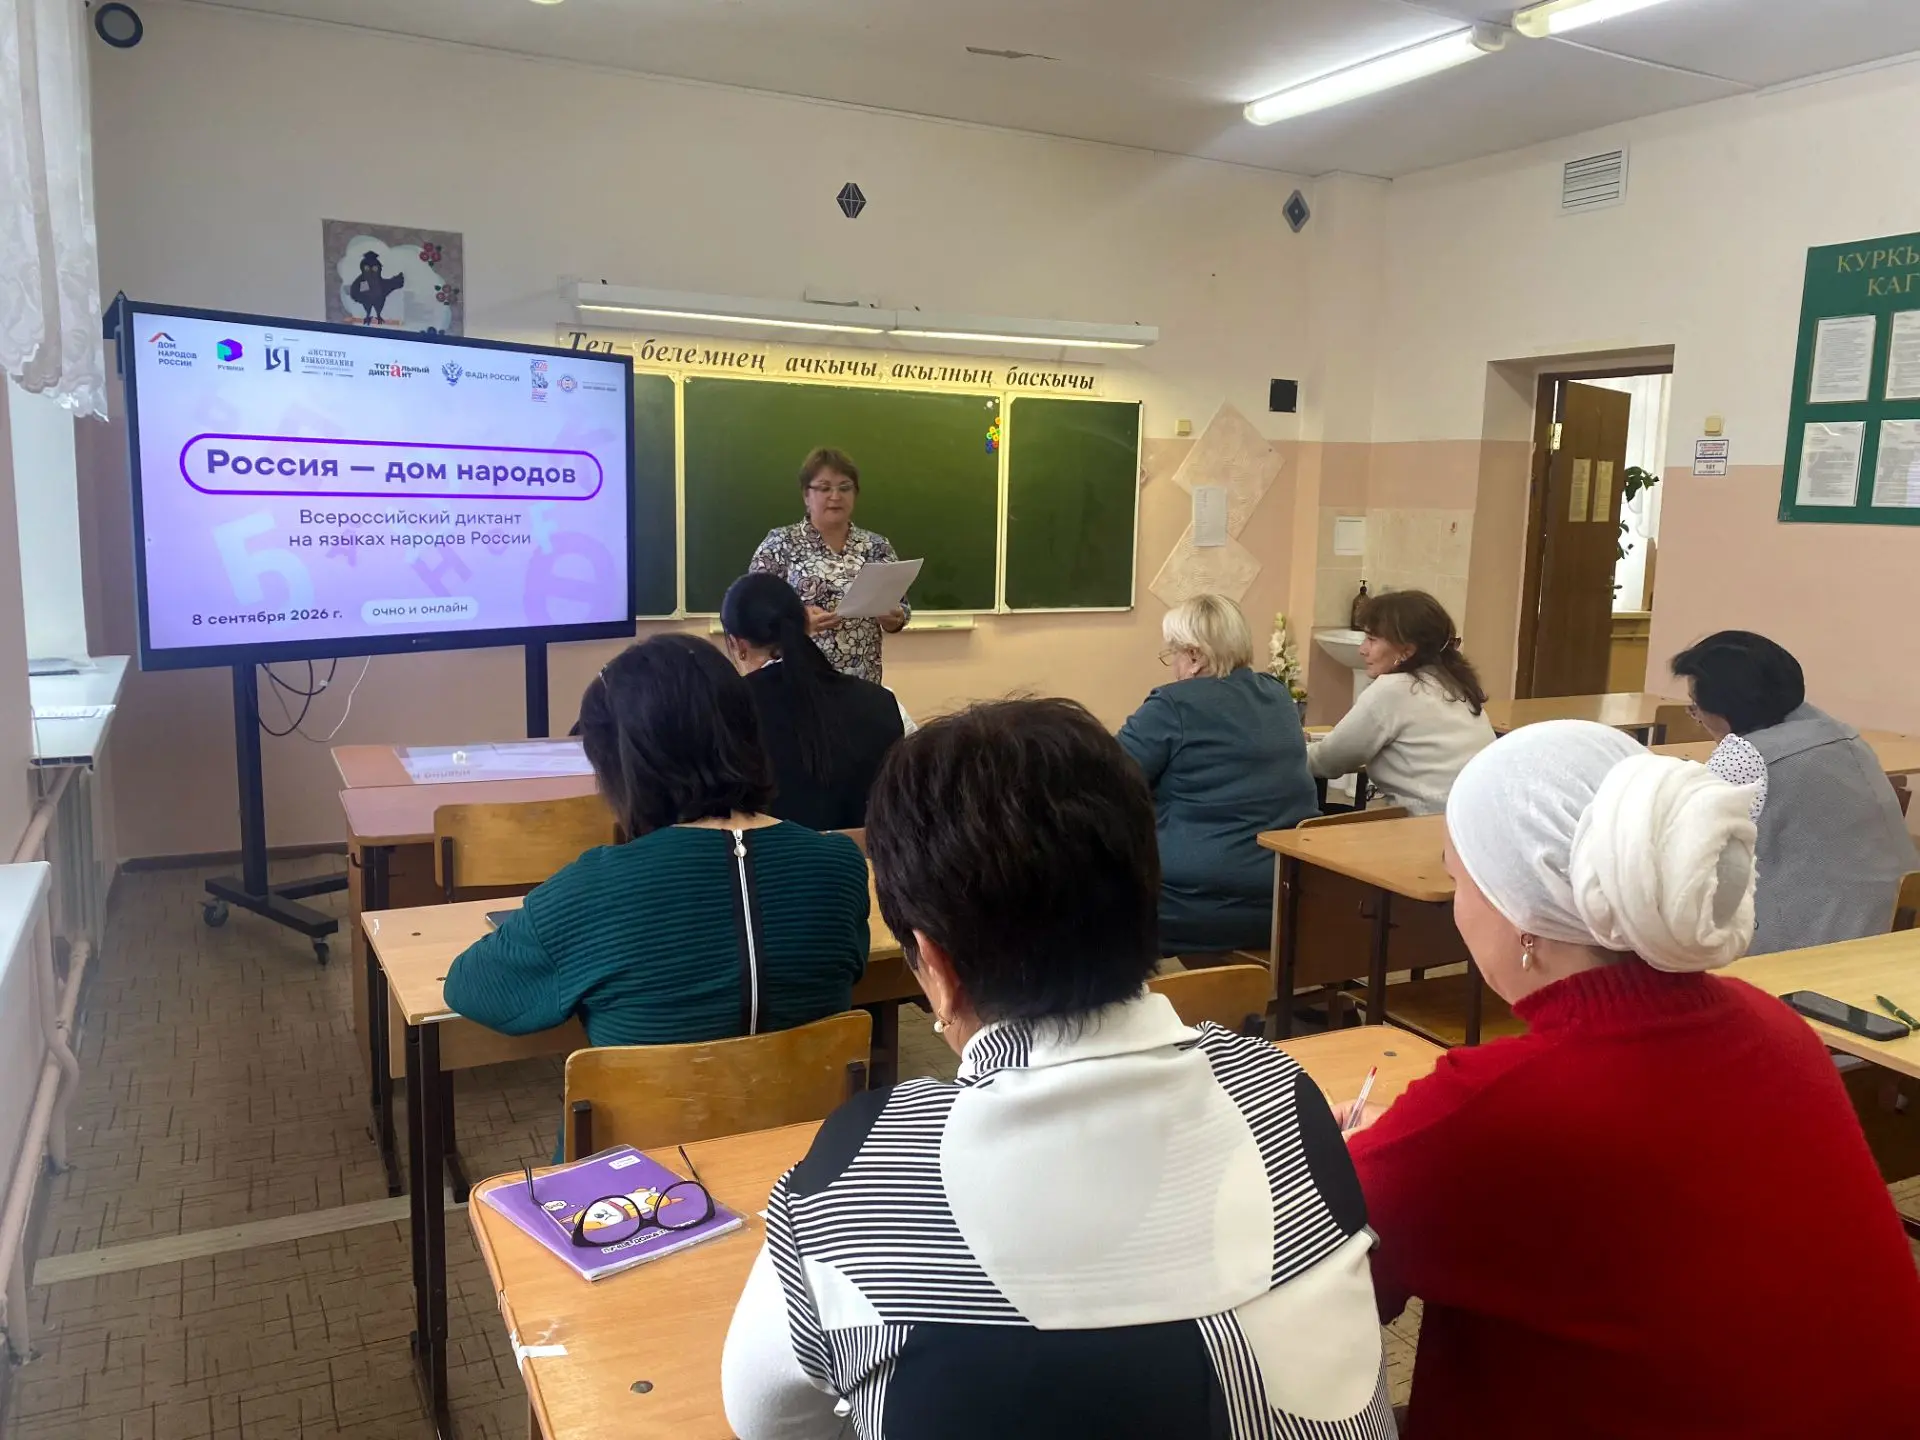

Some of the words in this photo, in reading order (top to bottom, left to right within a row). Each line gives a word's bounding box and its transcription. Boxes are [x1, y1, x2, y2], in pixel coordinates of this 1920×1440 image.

[158, 350, 197, 359] НАРОДОВ
[158, 358, 192, 367] РОССИИ
[568, 331, 614, 354] Тел
[641, 338, 766, 372] белемнең
[891, 363, 993, 387] акылның
[1006, 366, 1095, 390] баскычы
[465, 371, 488, 379] ФАДН
[489, 373, 520, 382] РОССИИ
[207, 448, 338, 477] Россия
[385, 461, 447, 483] дом
[457, 463, 576, 486] народов
[300, 509, 450, 527] Всероссийский
[455, 513, 521, 526] диктант
[289, 534, 312, 546] на
[319, 534, 385, 546] языках
[390, 533, 466, 548] народов
[471, 531, 531, 545] России
[192, 614, 202, 625] 8
[208, 611, 286, 624] сентября
[290, 609, 329, 620] 2026
[333, 610, 343, 618] г.
[372, 606, 405, 616] очно
[409, 606, 417, 614] и
[420, 602, 468, 614] онлайн
